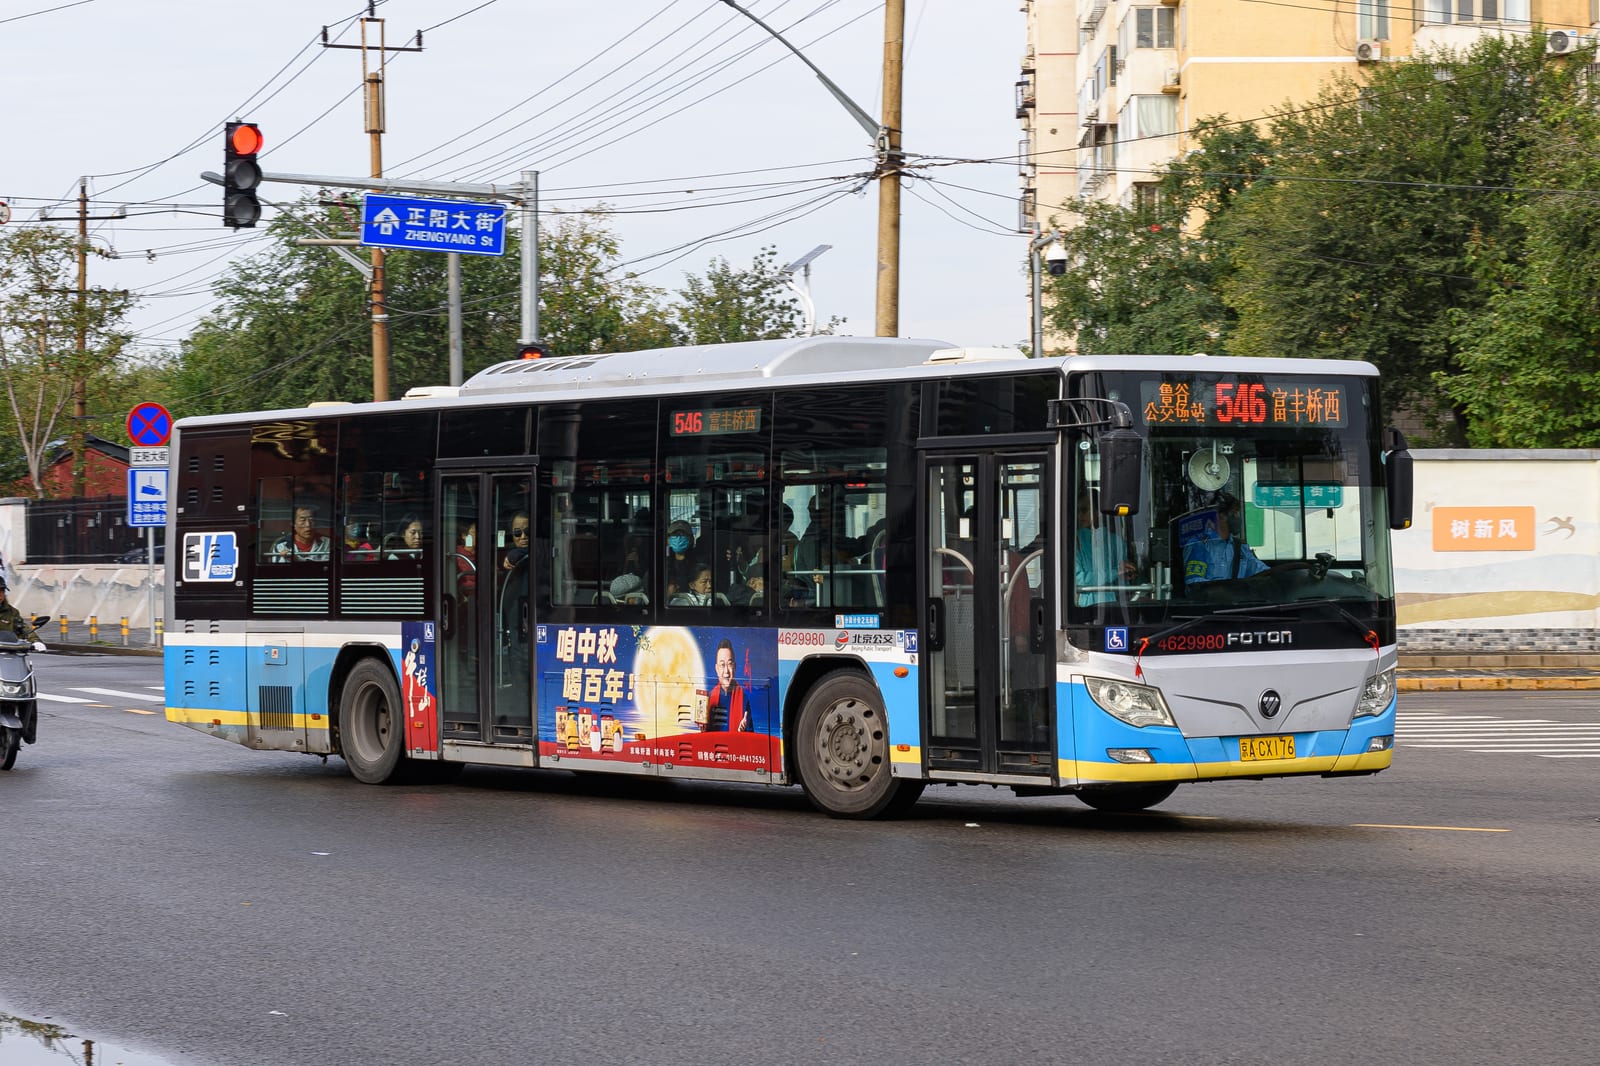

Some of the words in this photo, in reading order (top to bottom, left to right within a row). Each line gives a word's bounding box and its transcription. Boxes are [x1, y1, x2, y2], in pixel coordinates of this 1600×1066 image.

[405, 207, 495, 232] 正阳大街
[405, 229, 476, 245] ZHENGYANG
[480, 235, 494, 247] St
[1159, 383, 1190, 403] 鲁谷
[1215, 383, 1266, 423] 546
[1272, 388, 1341, 423] 富丰桥西
[675, 411, 703, 434] 546
[708, 409, 757, 432] 富丰桥西
[1451, 519, 1518, 539] 树新风
[556, 626, 619, 664] 咱中秋
[778, 631, 826, 646] 4629980
[852, 633, 894, 645] 北京公交
[1158, 634, 1225, 650] 4629980
[1227, 630, 1292, 645] FOTON
